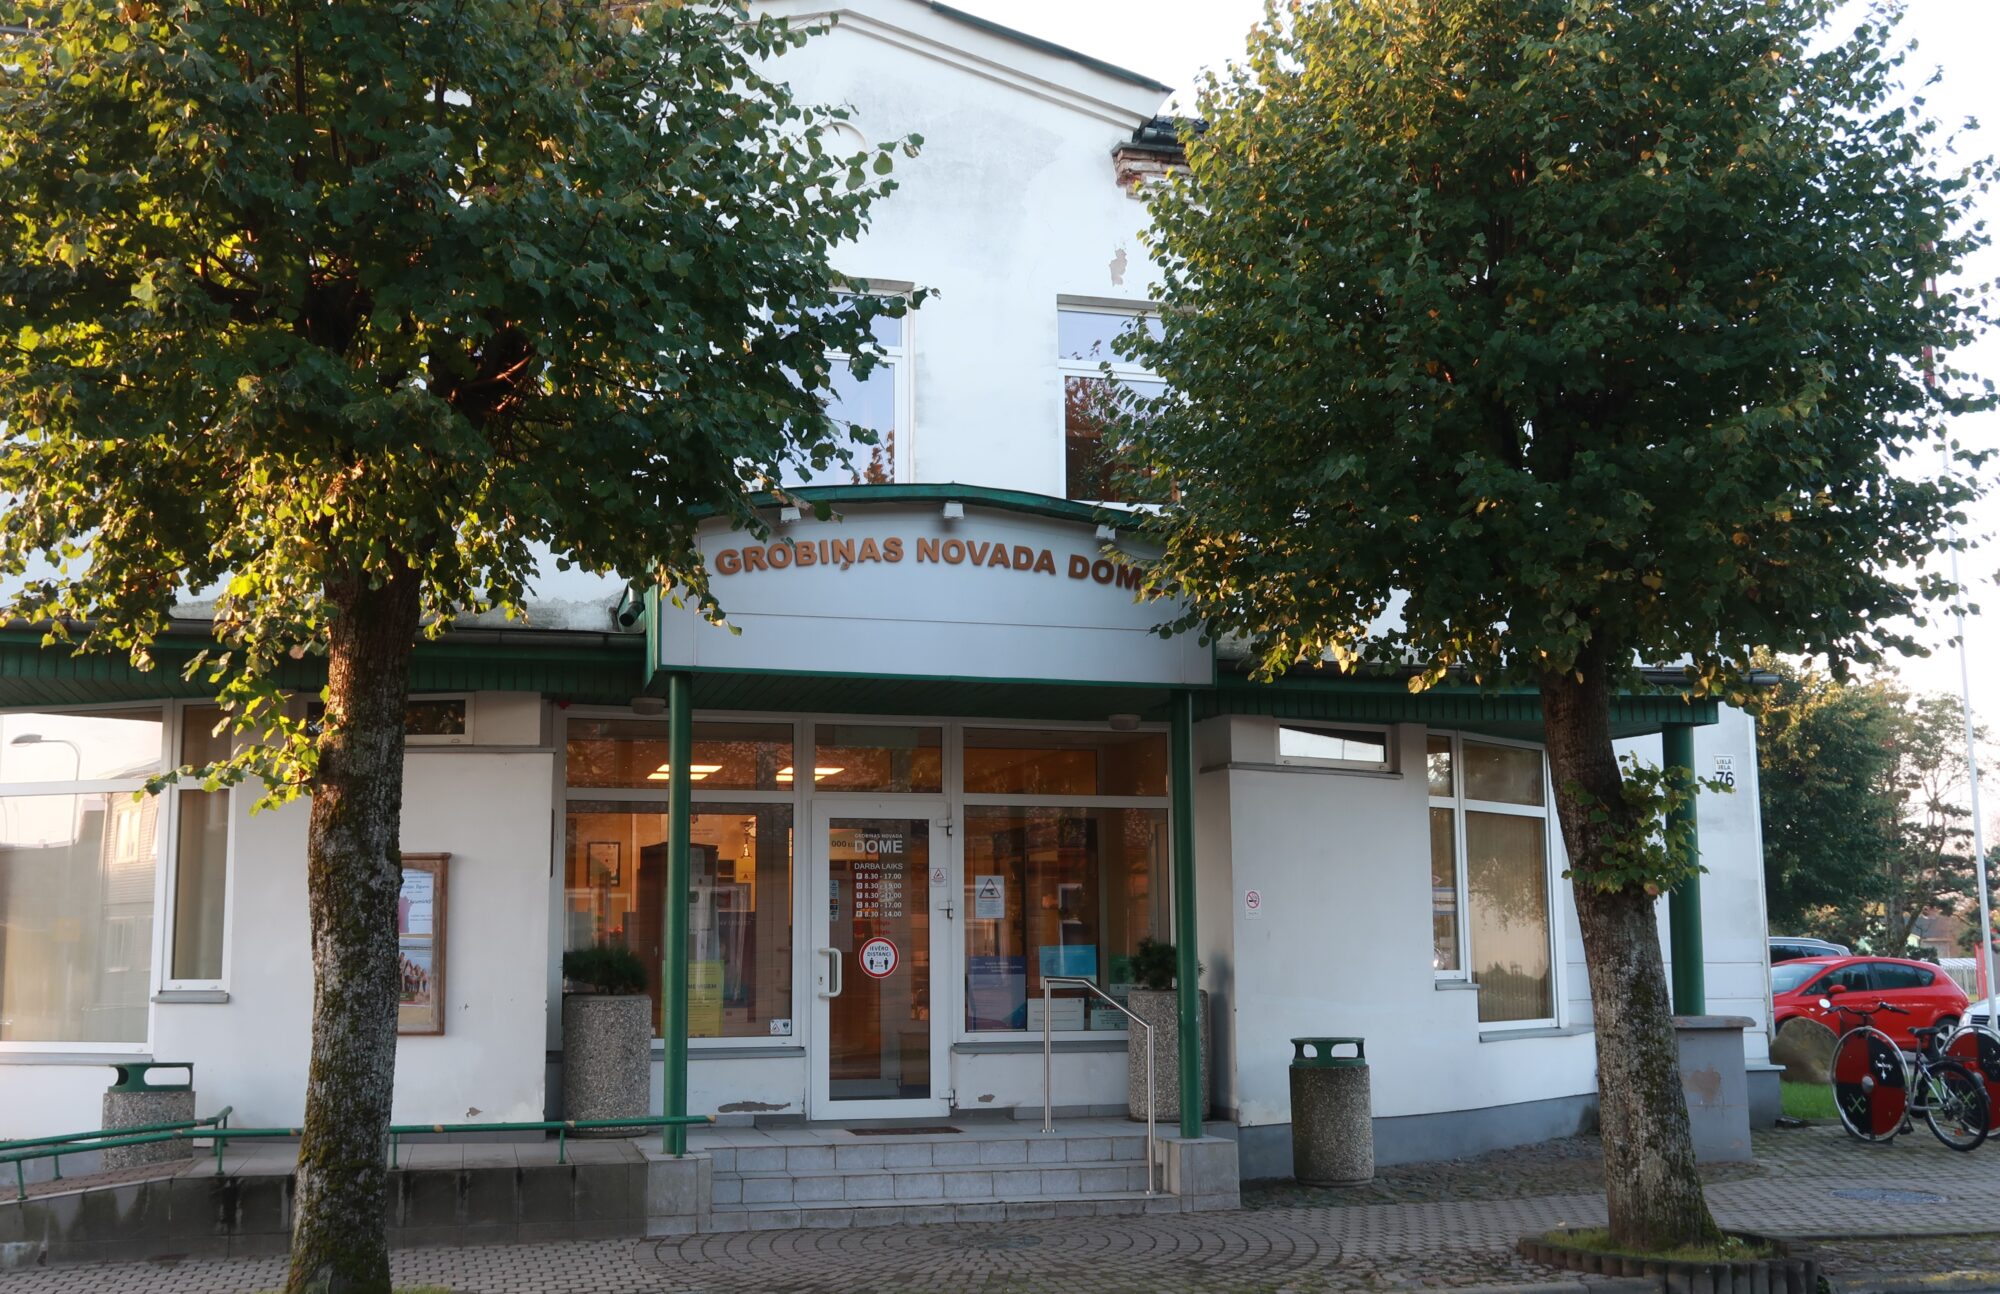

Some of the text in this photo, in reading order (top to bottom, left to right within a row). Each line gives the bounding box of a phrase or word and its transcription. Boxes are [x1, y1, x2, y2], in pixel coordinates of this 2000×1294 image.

[716, 537, 1161, 597] GROBIŅAS NOVADA DOM
[1715, 771, 1735, 787] 76
[854, 840, 903, 854] DOME
